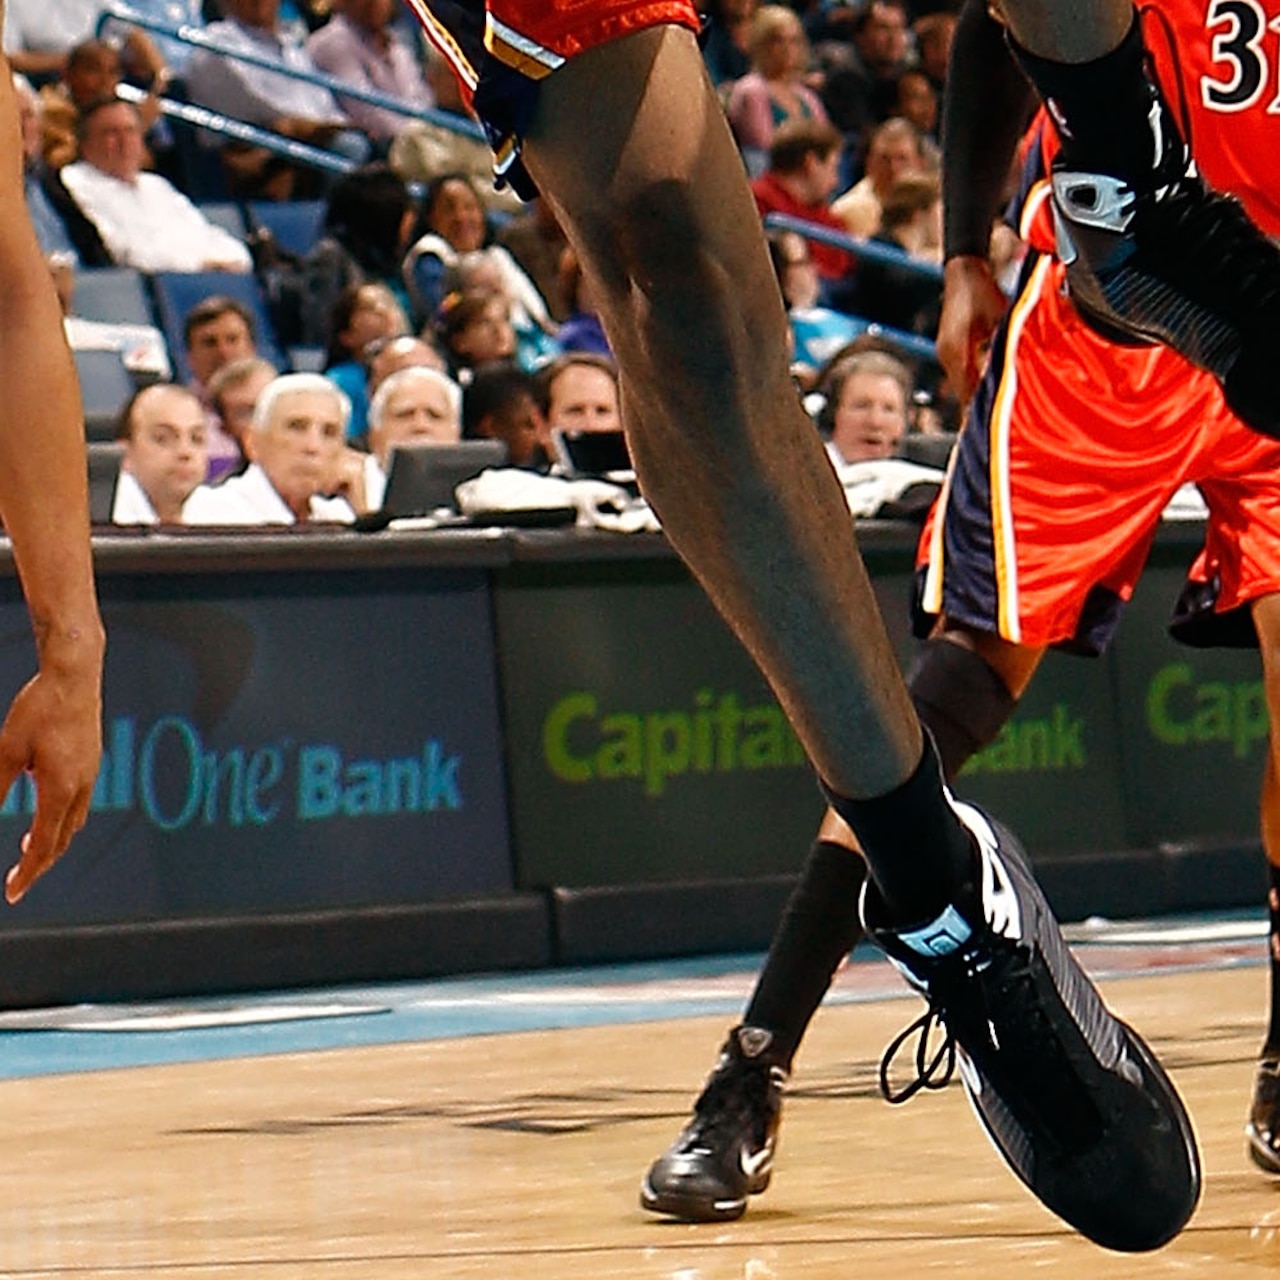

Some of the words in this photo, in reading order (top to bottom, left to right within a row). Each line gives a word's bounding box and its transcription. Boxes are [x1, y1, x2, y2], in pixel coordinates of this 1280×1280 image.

[140, 714, 284, 830] One
[299, 740, 463, 819] Bank
[955, 701, 1086, 775] ank
